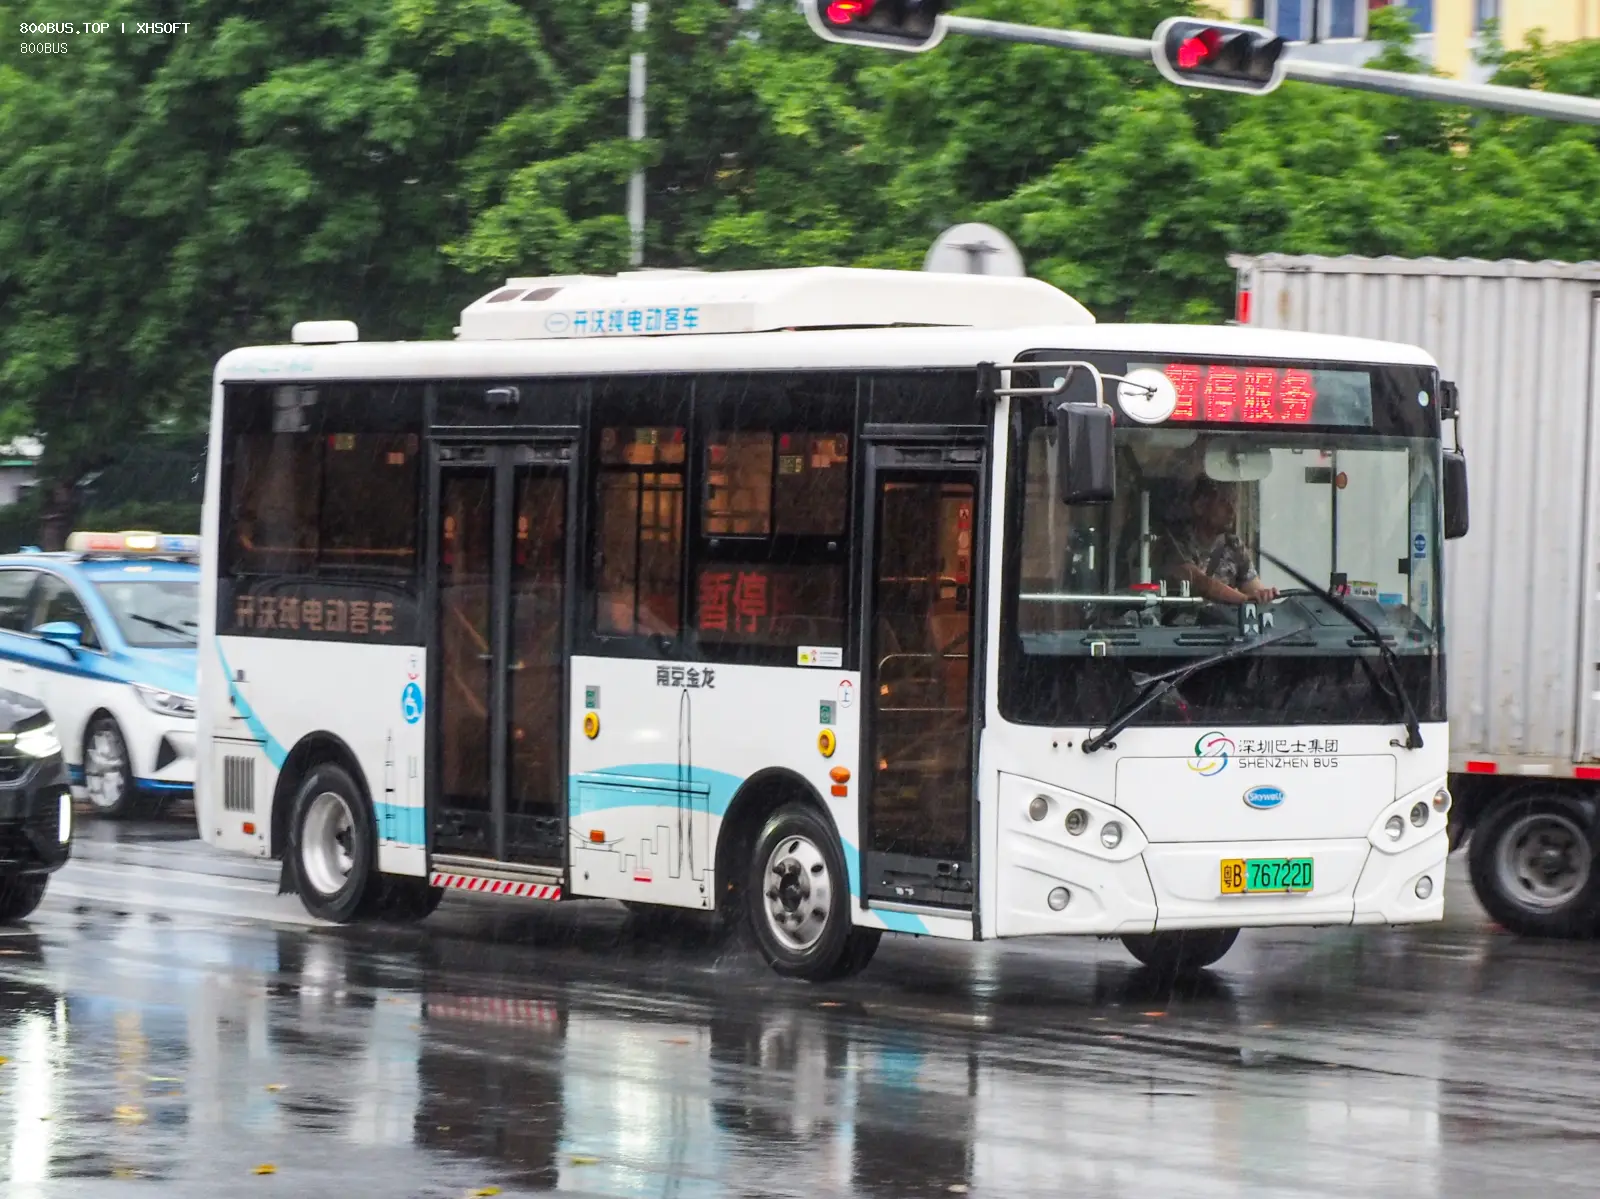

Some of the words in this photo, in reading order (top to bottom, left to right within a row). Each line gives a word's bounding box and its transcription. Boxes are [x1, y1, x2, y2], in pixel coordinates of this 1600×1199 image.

[574, 307, 699, 334] 开沃纯电动客车
[234, 594, 394, 635] 开沃纯电动客车
[656, 665, 715, 689] 南京金龙
[1238, 738, 1339, 754] 深圳巴士集团
[1238, 758, 1309, 769] SHENZHEN
[1313, 757, 1339, 768] BUS
